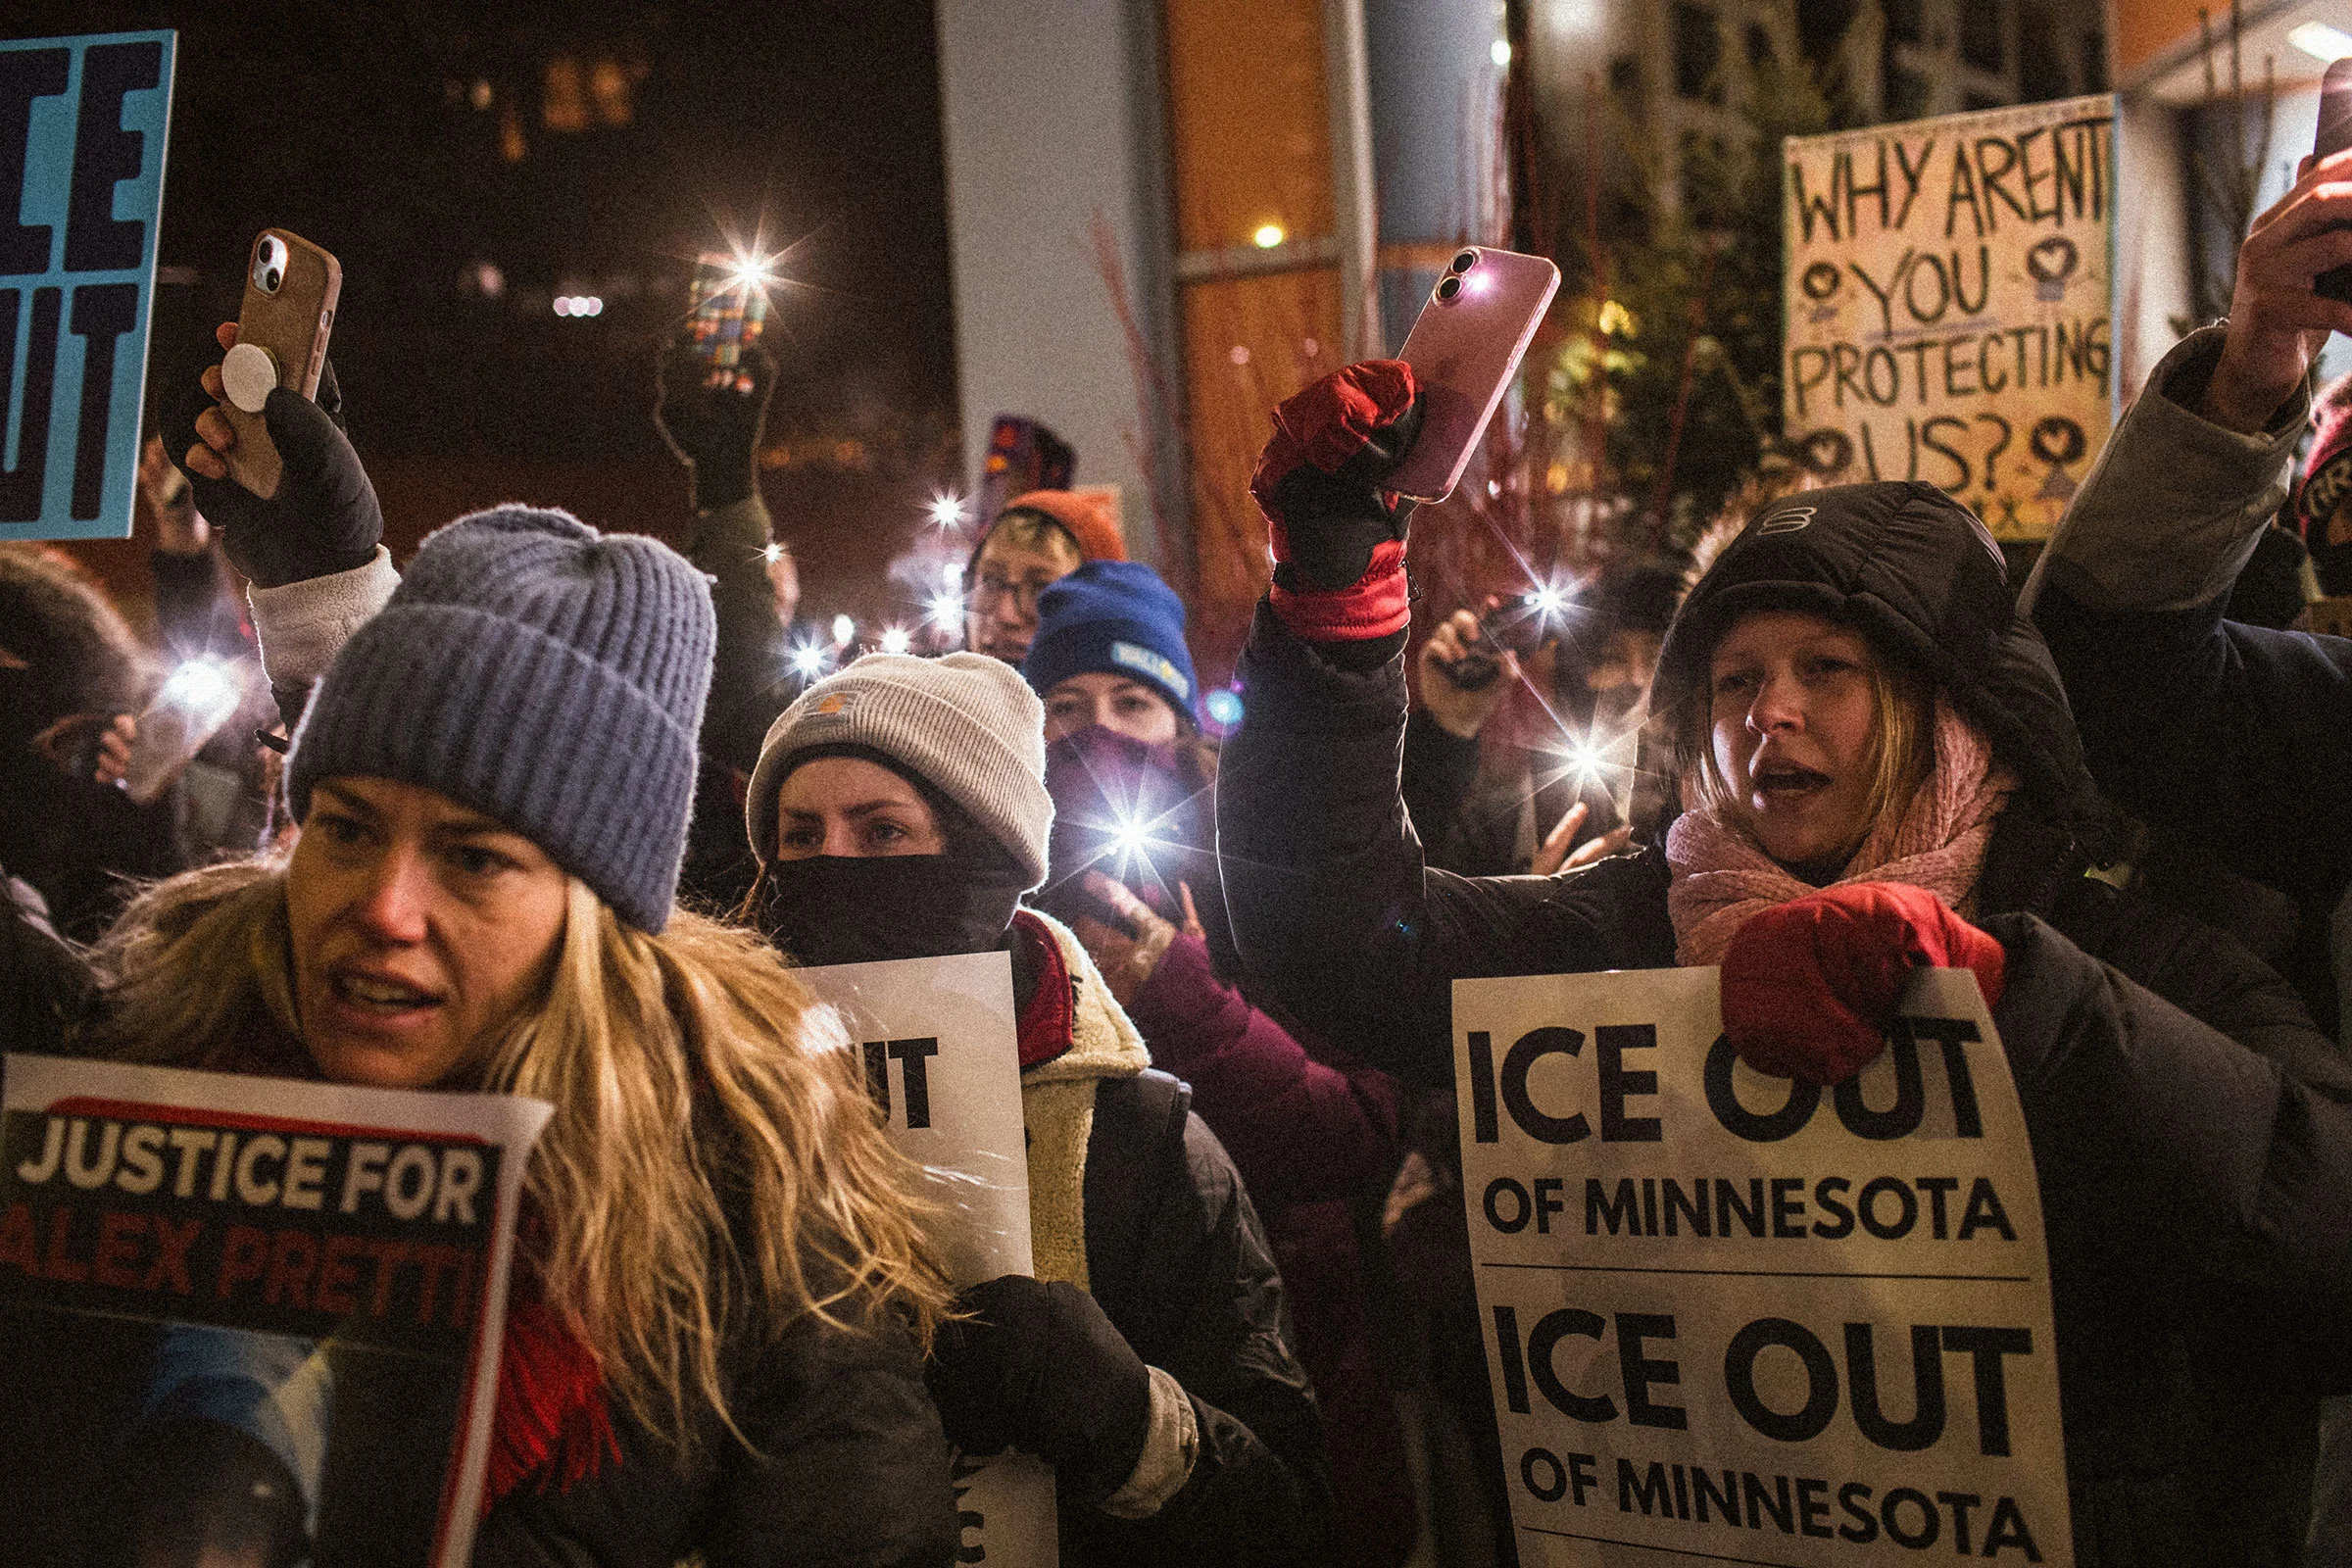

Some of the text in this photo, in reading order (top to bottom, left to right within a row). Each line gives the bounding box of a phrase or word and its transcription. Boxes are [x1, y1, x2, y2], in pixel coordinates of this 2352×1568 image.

[1792, 115, 2114, 243] WHY ARENT
[1849, 245, 1990, 338] YOU
[1792, 318, 2111, 418] PROTECTING
[1861, 413, 2013, 490] US?
[1467, 1016, 1984, 1145] ICE OUT
[18, 1117, 484, 1224] JUSTICE FOR
[1483, 1177, 2019, 1242] OF MINNESOTA
[0, 1202, 477, 1328] ALEX PRETTI
[1493, 1305, 2034, 1458] ICE OUT
[1519, 1447, 2044, 1564] OF MINNESOTA
